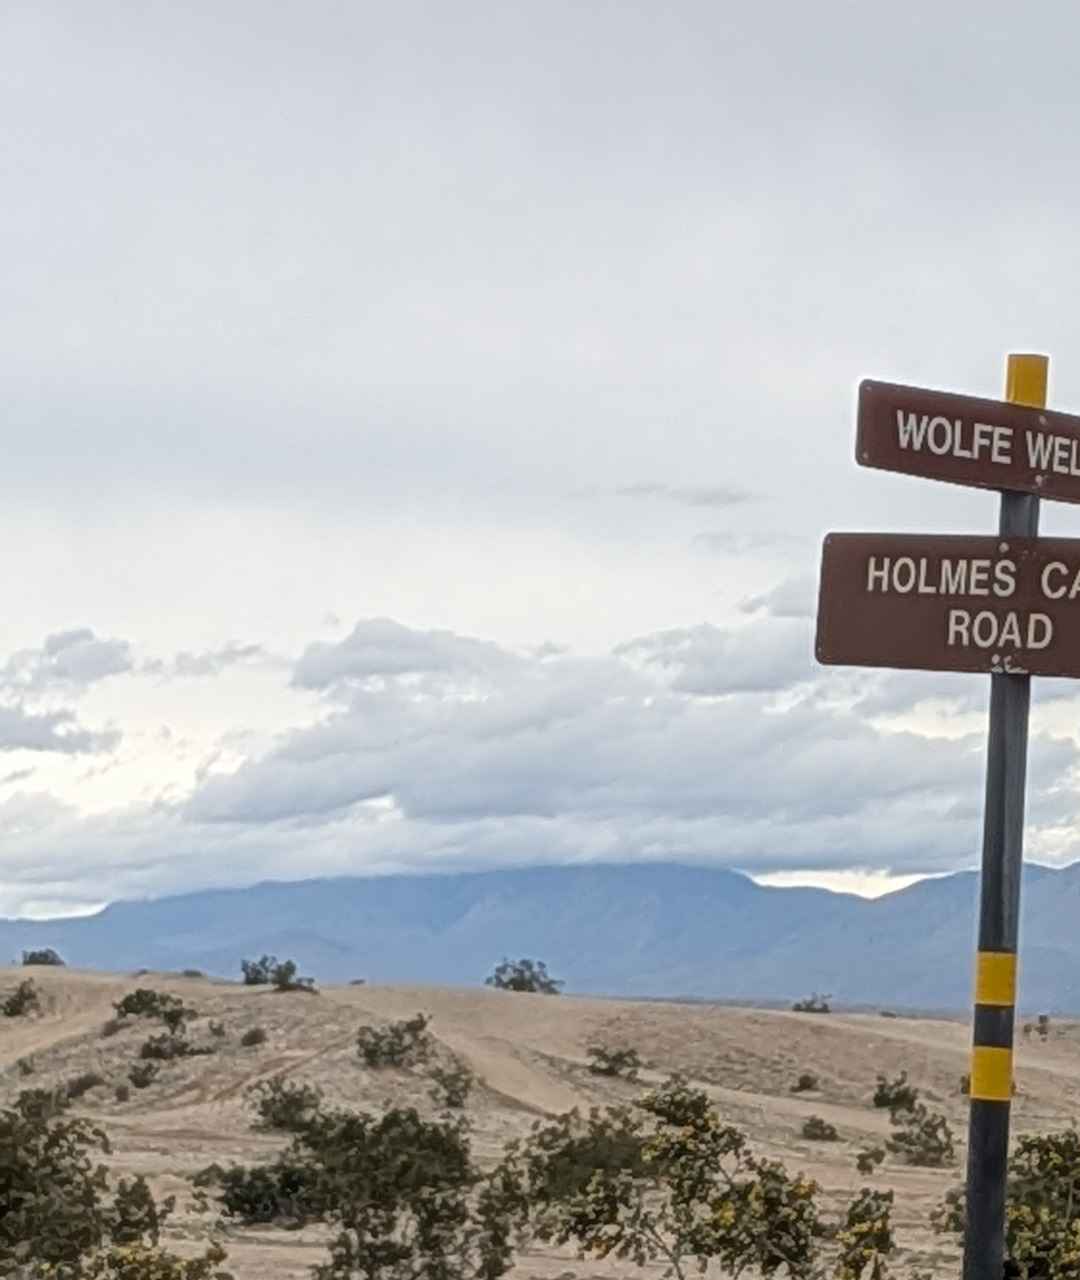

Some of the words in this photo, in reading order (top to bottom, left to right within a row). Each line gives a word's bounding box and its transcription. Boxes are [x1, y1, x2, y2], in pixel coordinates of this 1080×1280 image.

[896, 409, 1013, 464] WOLFE
[867, 557, 1016, 597] HOLMES
[948, 610, 1053, 649] ROAD
